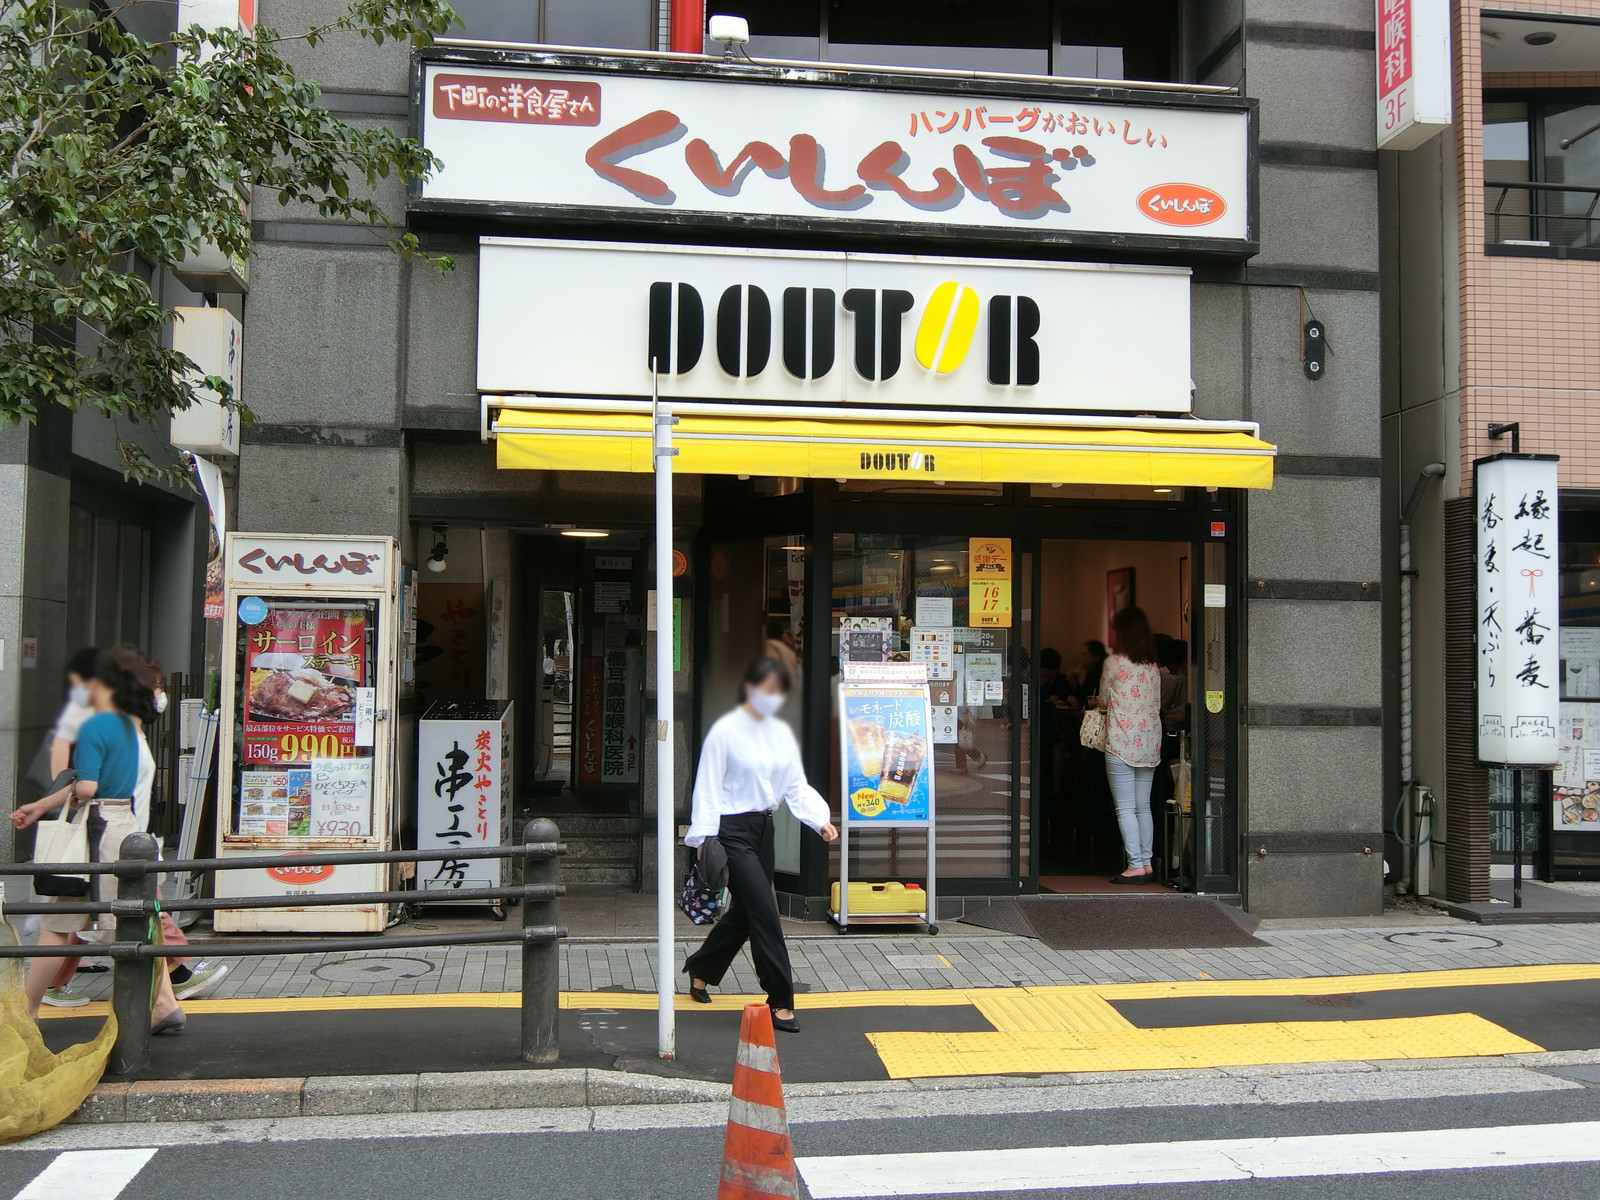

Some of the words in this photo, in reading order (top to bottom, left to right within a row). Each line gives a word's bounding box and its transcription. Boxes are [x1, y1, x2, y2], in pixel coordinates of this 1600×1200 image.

[440, 83, 596, 120] 下町の洋食屋さん
[1385, 88, 1407, 130] 3F
[909, 105, 1169, 149] ハンバーグがおいしい
[585, 109, 1096, 219] くいしんぼ
[1147, 196, 1215, 215] くいしんぼ
[649, 281, 1040, 386] DOUTOR
[860, 451, 936, 473] DOUTOR
[238, 548, 381, 575] くいしんぼ
[973, 553, 1008, 564] 感謝デー
[983, 586, 1000, 599] 16
[982, 599, 1000, 611] 17
[252, 630, 361, 654] サーロイン
[301, 653, 360, 670] ステーキ
[848, 697, 904, 716] レモネード
[888, 710, 922, 730] 炭酸
[247, 744, 278, 763] 150g
[628, 753, 636, 772] 3F
[272, 777, 288, 786] ¥50
[316, 773, 330, 781] B
[473, 730, 492, 841] 炭火やきとり
[317, 820, 361, 836] ¥930
